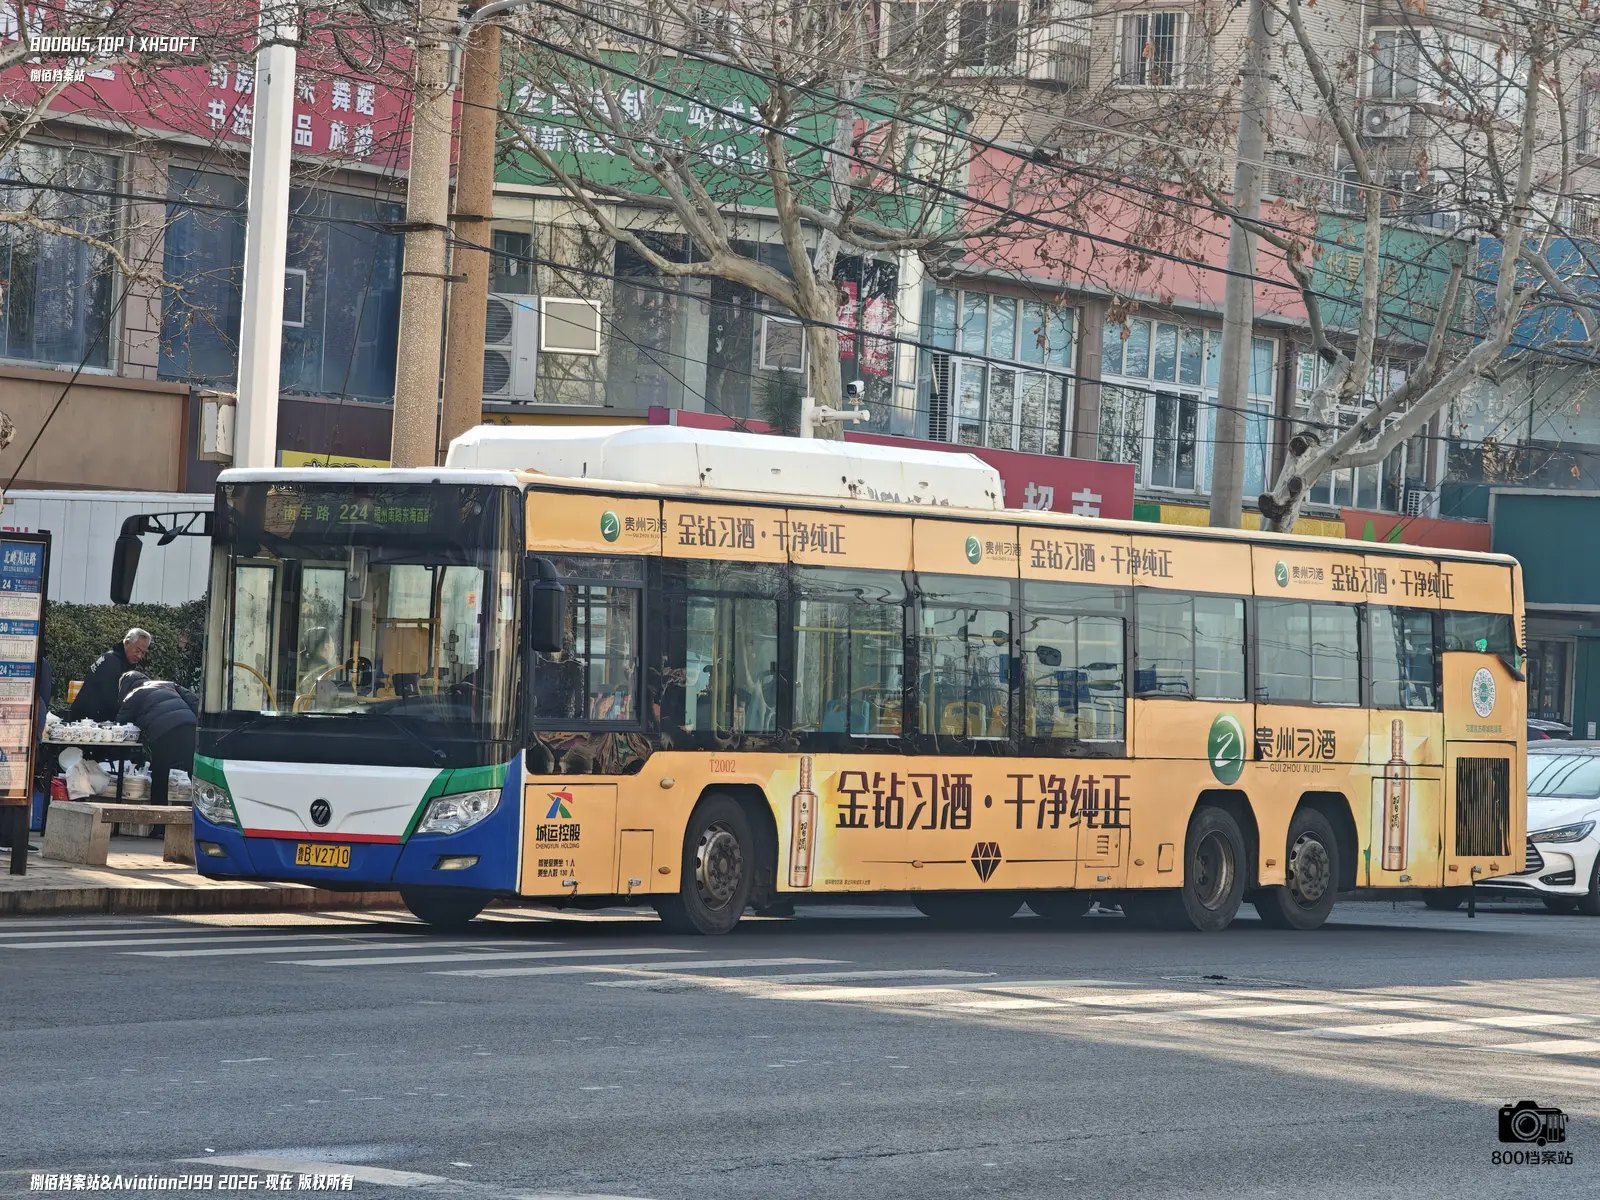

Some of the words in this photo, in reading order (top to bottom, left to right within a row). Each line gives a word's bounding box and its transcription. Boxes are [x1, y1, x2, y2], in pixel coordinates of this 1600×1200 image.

[331, 81, 376, 116] 舞蹈
[294, 114, 312, 147] 品
[283, 504, 330, 521] 南丰路
[339, 504, 369, 520] 224
[625, 516, 668, 533] 贵州习酒
[1256, 726, 1336, 759] 贵州习酒
[709, 759, 736, 773] T2002
[836, 770, 1131, 830] 金钻习酒·干净纯正
[536, 823, 581, 842] 城运控股
[570, 858, 576, 867] 人
[569, 868, 575, 877] 人
